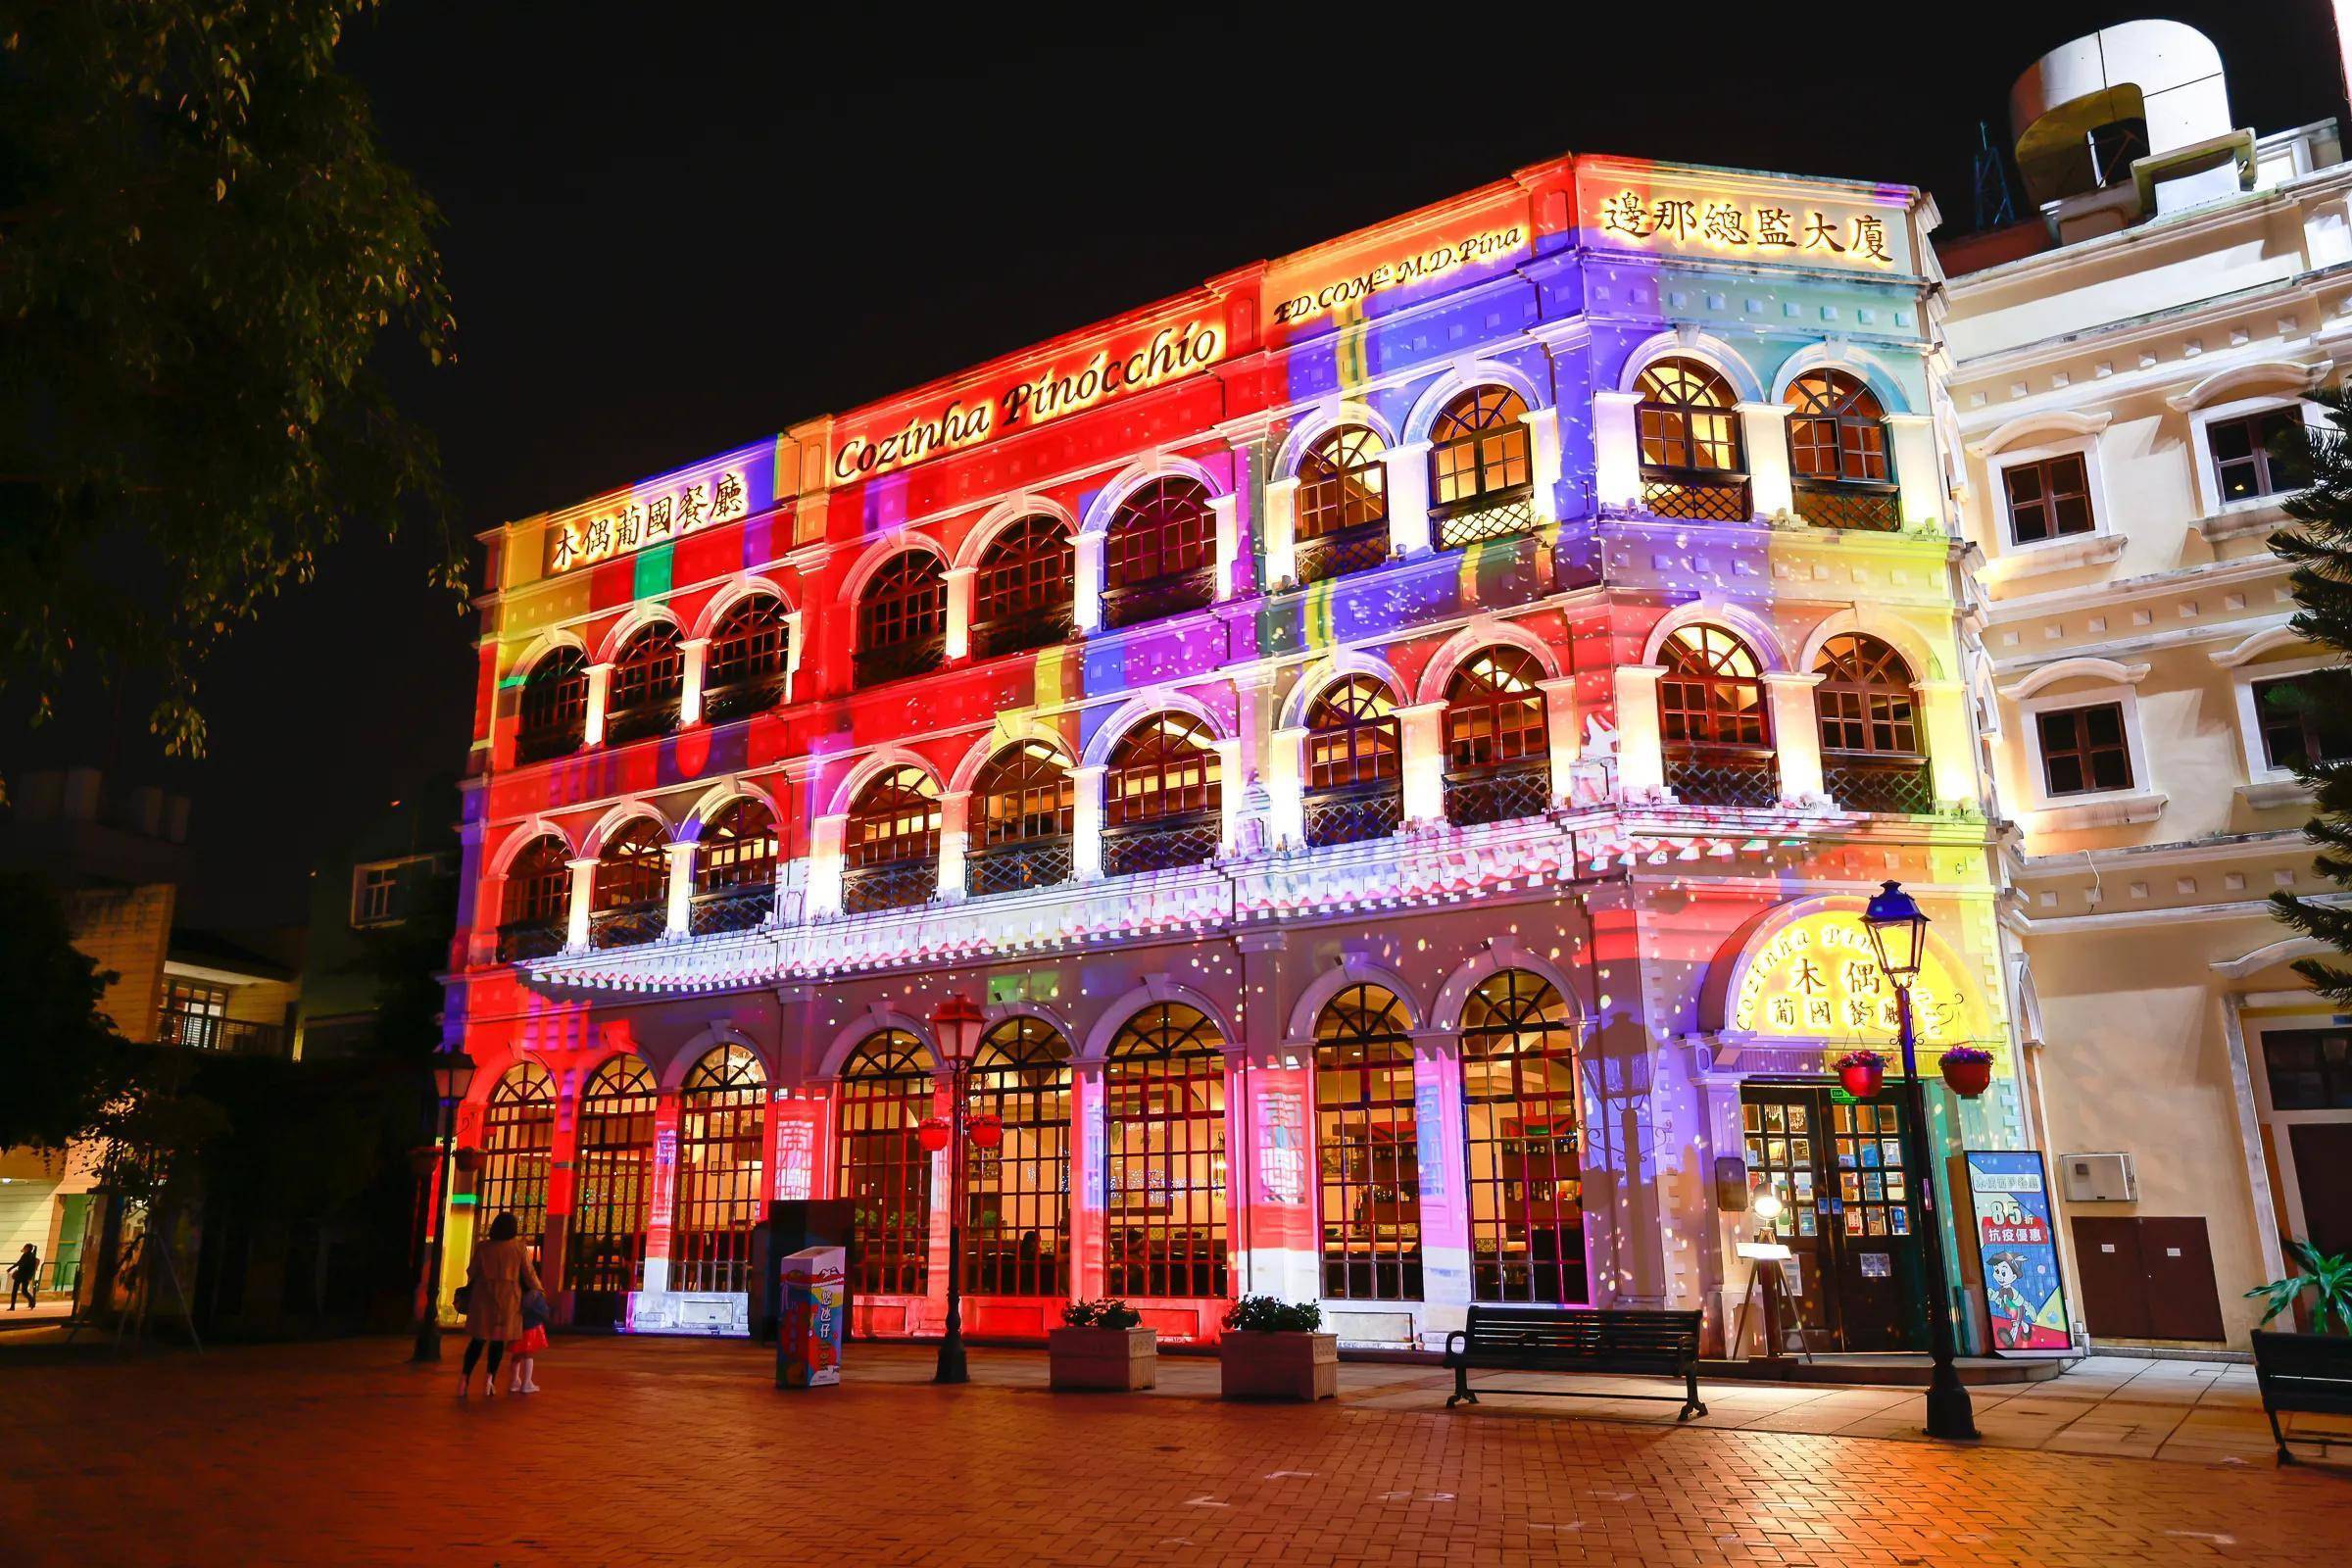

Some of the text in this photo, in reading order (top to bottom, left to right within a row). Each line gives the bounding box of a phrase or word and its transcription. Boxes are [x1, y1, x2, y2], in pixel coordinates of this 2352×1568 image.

[1605, 192, 1893, 263] 邊那總監大廈
[834, 322, 1216, 479] Cozinha Pinócchio
[553, 473, 746, 565] 木偶葡國餐廳
[1793, 958, 1881, 995] 木偶
[1988, 1228, 2042, 1243] 抗疫優惠
